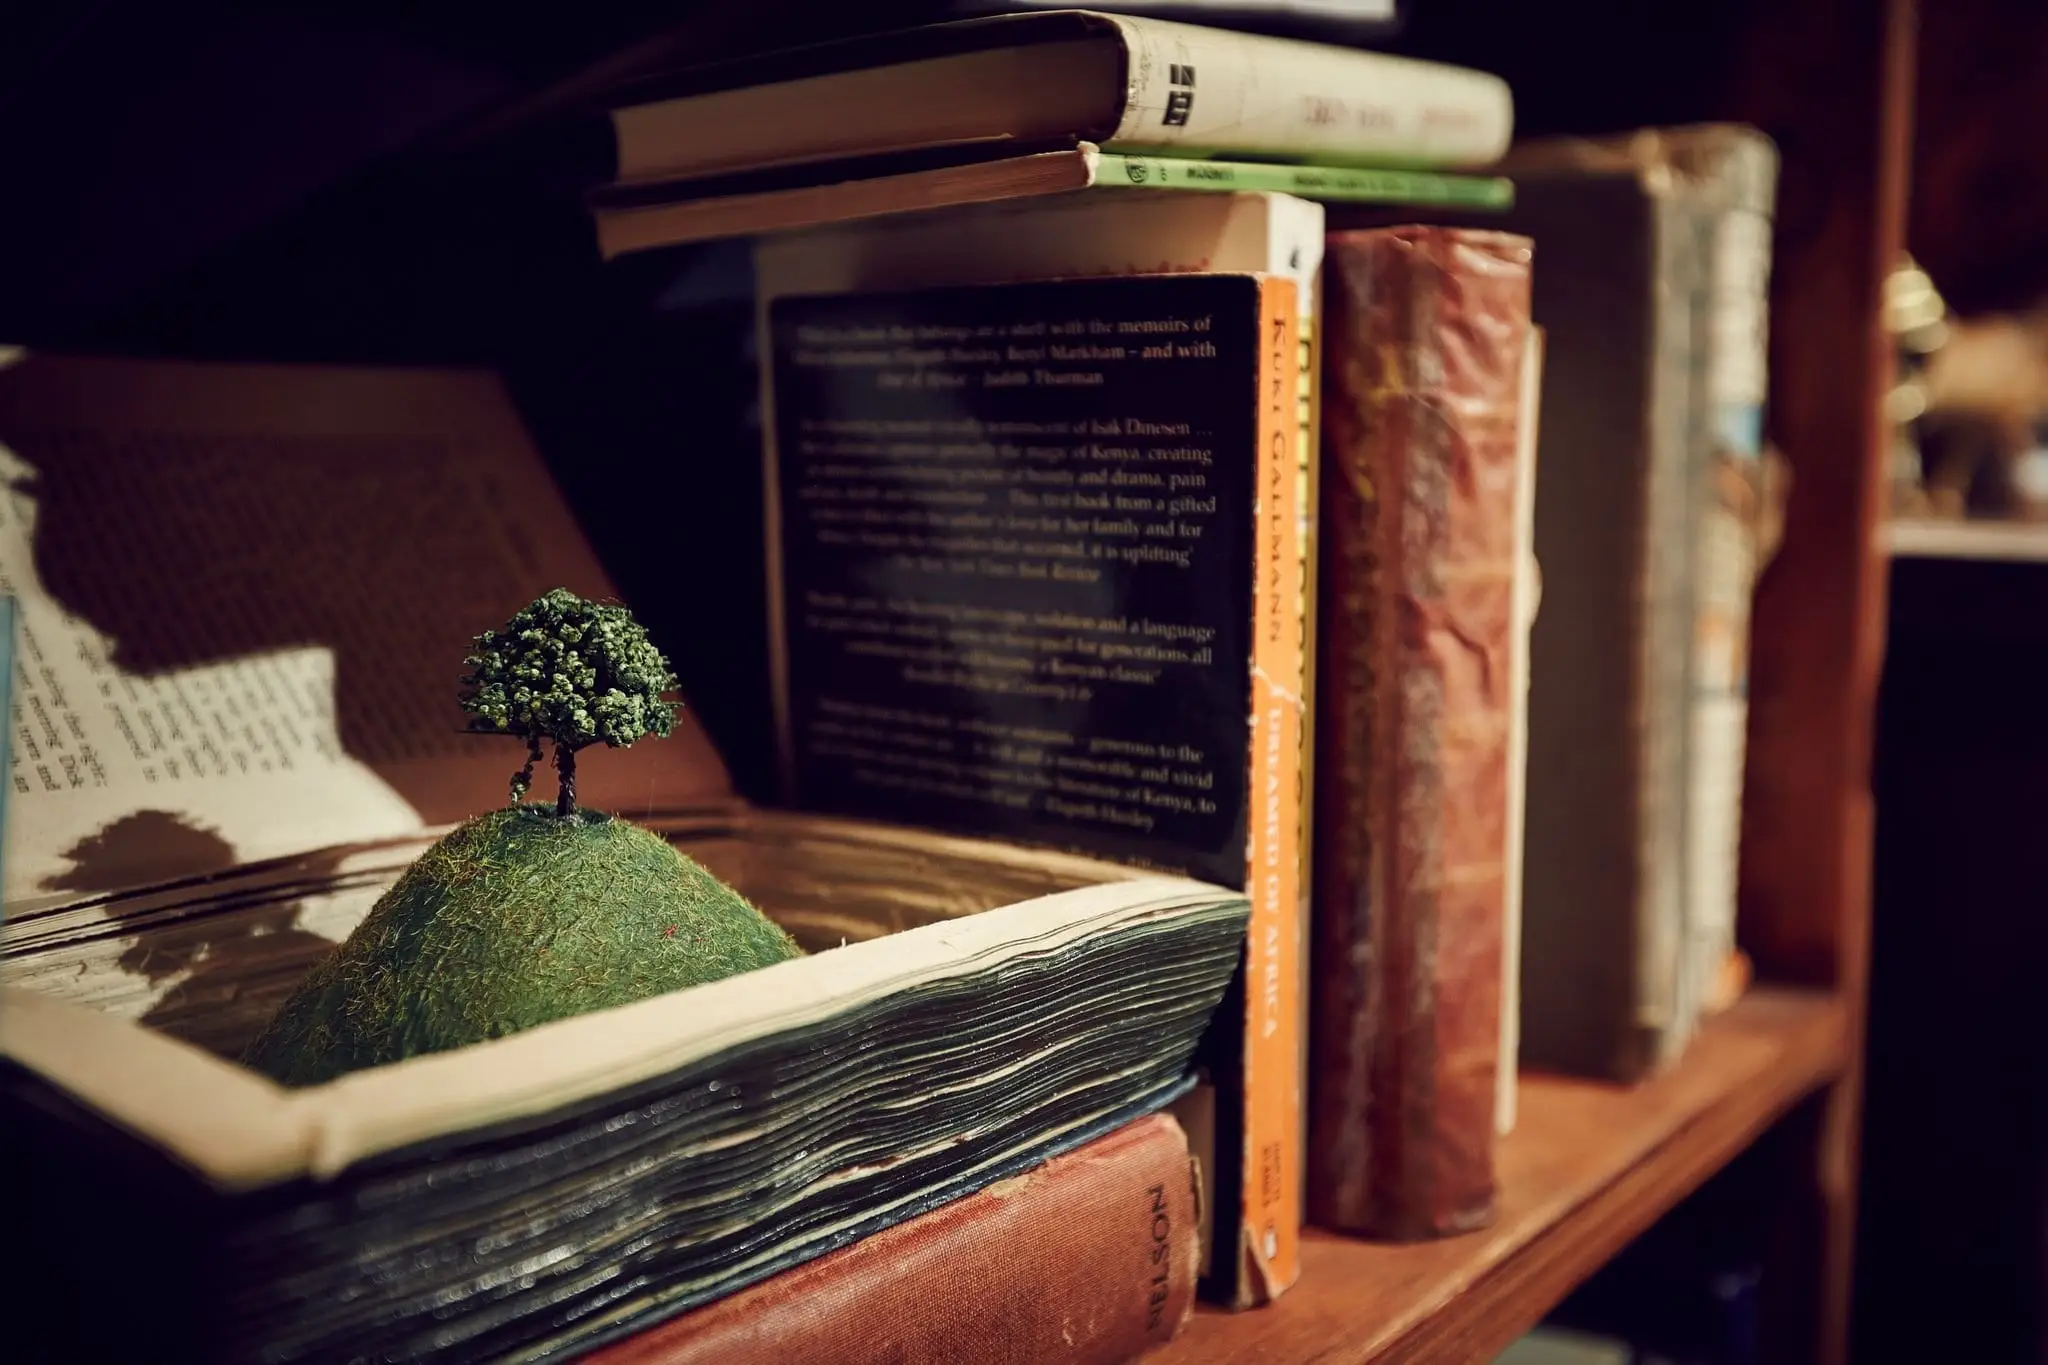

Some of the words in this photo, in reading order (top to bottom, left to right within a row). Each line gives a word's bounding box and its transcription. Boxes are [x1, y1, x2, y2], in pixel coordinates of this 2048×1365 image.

[1116, 314, 1190, 335] memoirs
[1192, 312, 1214, 333] of
[1049, 342, 1126, 362] Markham
[1141, 341, 1173, 359] and
[1176, 339, 1217, 359] with
[1124, 418, 1190, 437] Dinesen
[1147, 445, 1214, 467] creating
[1077, 467, 1108, 486] and
[1168, 472, 1207, 493] pain
[1113, 493, 1152, 511] from
[1156, 498, 1166, 512] a
[1168, 494, 1217, 518] gifted
[1093, 516, 1140, 541] family
[1145, 519, 1175, 538] and
[1177, 519, 1204, 538] for
[1269, 428, 1286, 645] GALLMANN
[1099, 615, 1128, 635] and
[1130, 619, 1140, 636] a
[1141, 616, 1216, 645] language
[1190, 645, 1213, 667] all
[1159, 740, 1177, 759] to
[1177, 740, 1204, 763] the
[36, 763, 62, 792] and
[58, 753, 85, 789] Dick
[1139, 764, 1169, 785] and
[1171, 765, 1215, 791] vivid
[1266, 707, 1283, 868] DREAMED
[1142, 786, 1197, 817] Kenya,
[1197, 796, 1218, 815] to
[1265, 872, 1281, 914] OF
[1261, 921, 1281, 1040] AFRICA
[1146, 1181, 1170, 1335] NELSON
